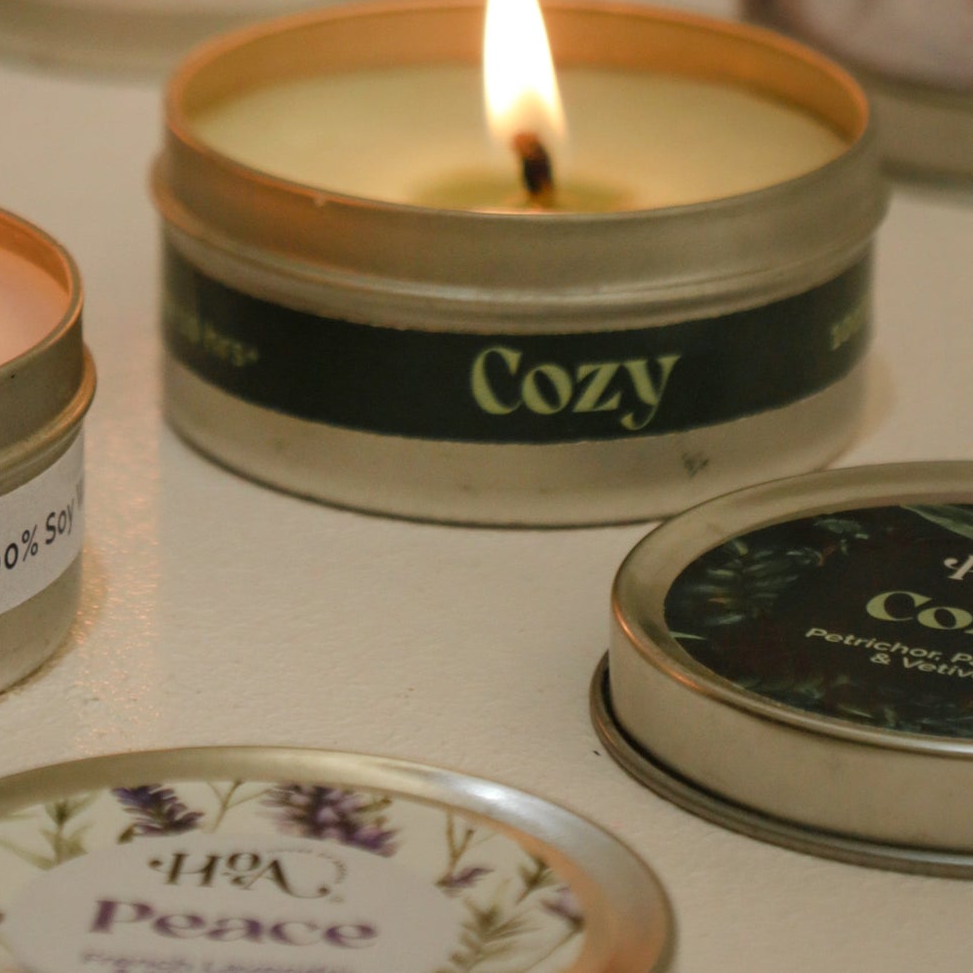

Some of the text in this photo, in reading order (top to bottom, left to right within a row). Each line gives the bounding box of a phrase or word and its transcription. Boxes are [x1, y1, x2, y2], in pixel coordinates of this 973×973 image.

[470, 347, 682, 431] Cozy
[45, 498, 75, 545] Soy
[866, 590, 973, 635] Co
[870, 652, 891, 665] &
[88, 899, 378, 949] Peace
